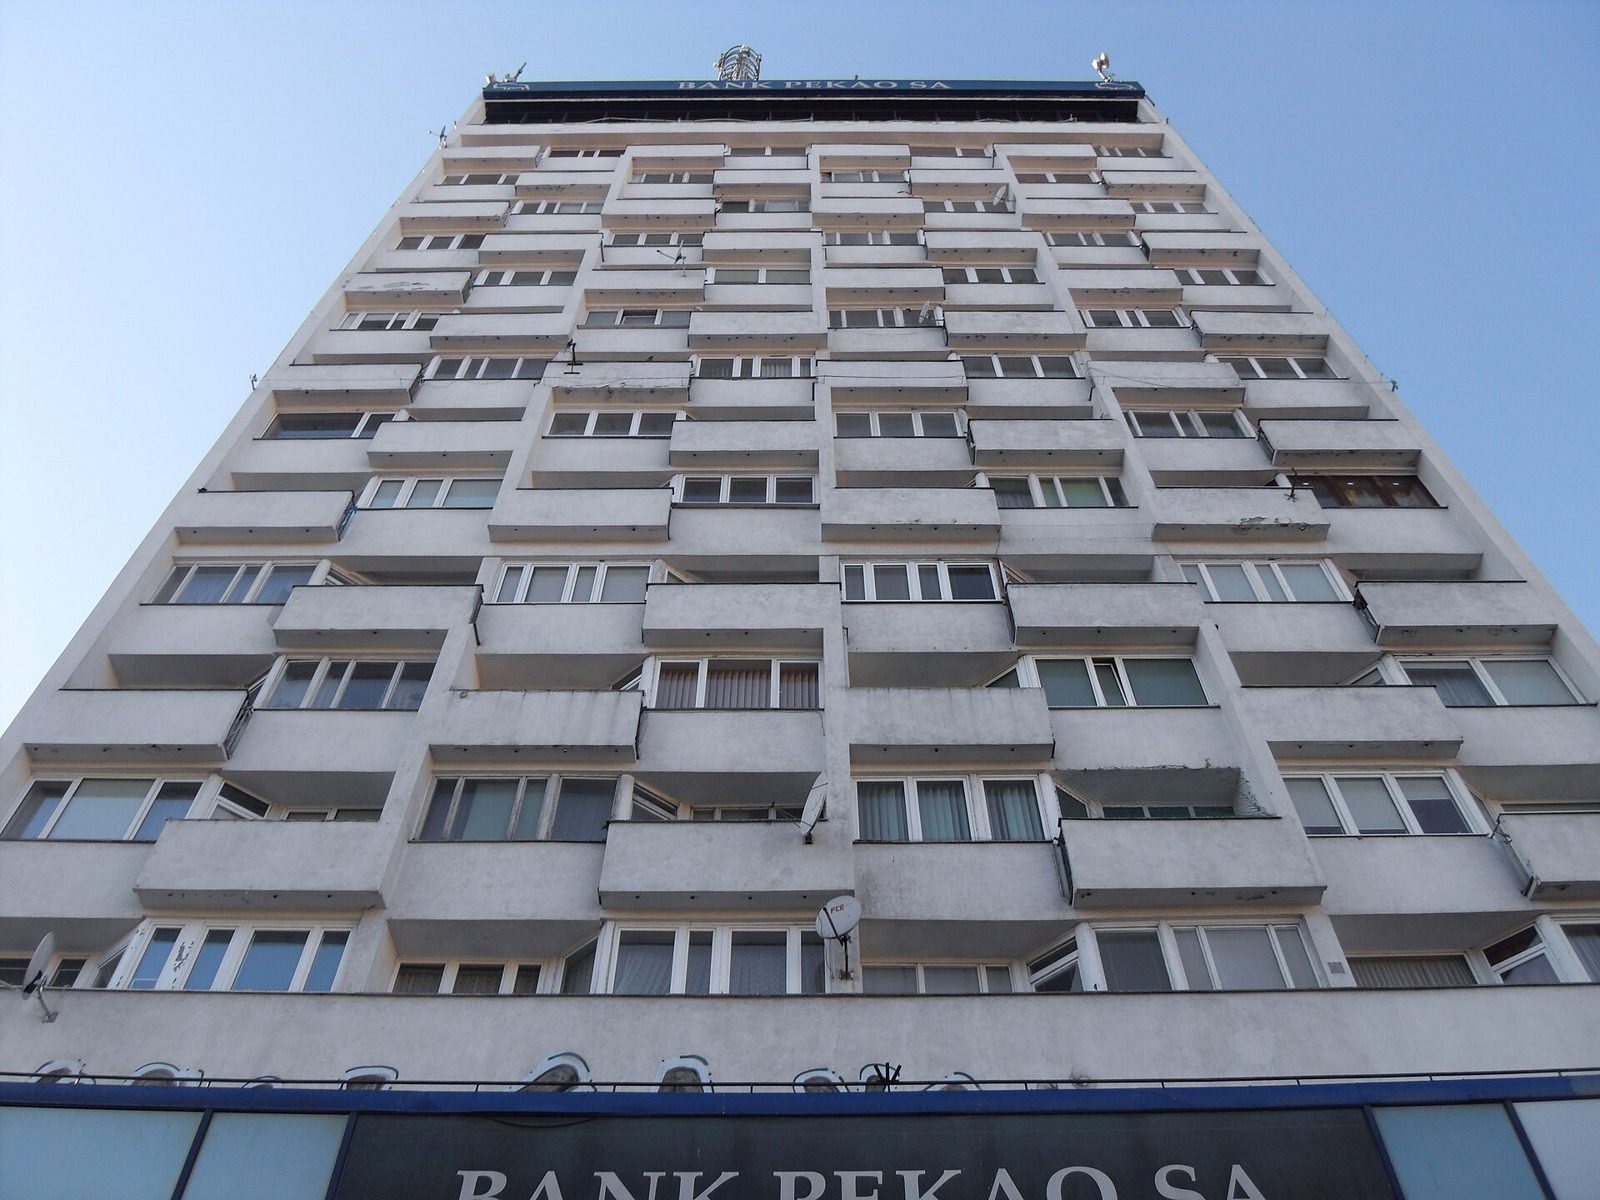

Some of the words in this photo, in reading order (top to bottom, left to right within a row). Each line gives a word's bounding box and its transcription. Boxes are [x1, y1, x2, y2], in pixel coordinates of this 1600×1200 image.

[678, 81, 772, 90] BANK
[784, 80, 898, 90] PEKAO
[910, 80, 952, 90] SA
